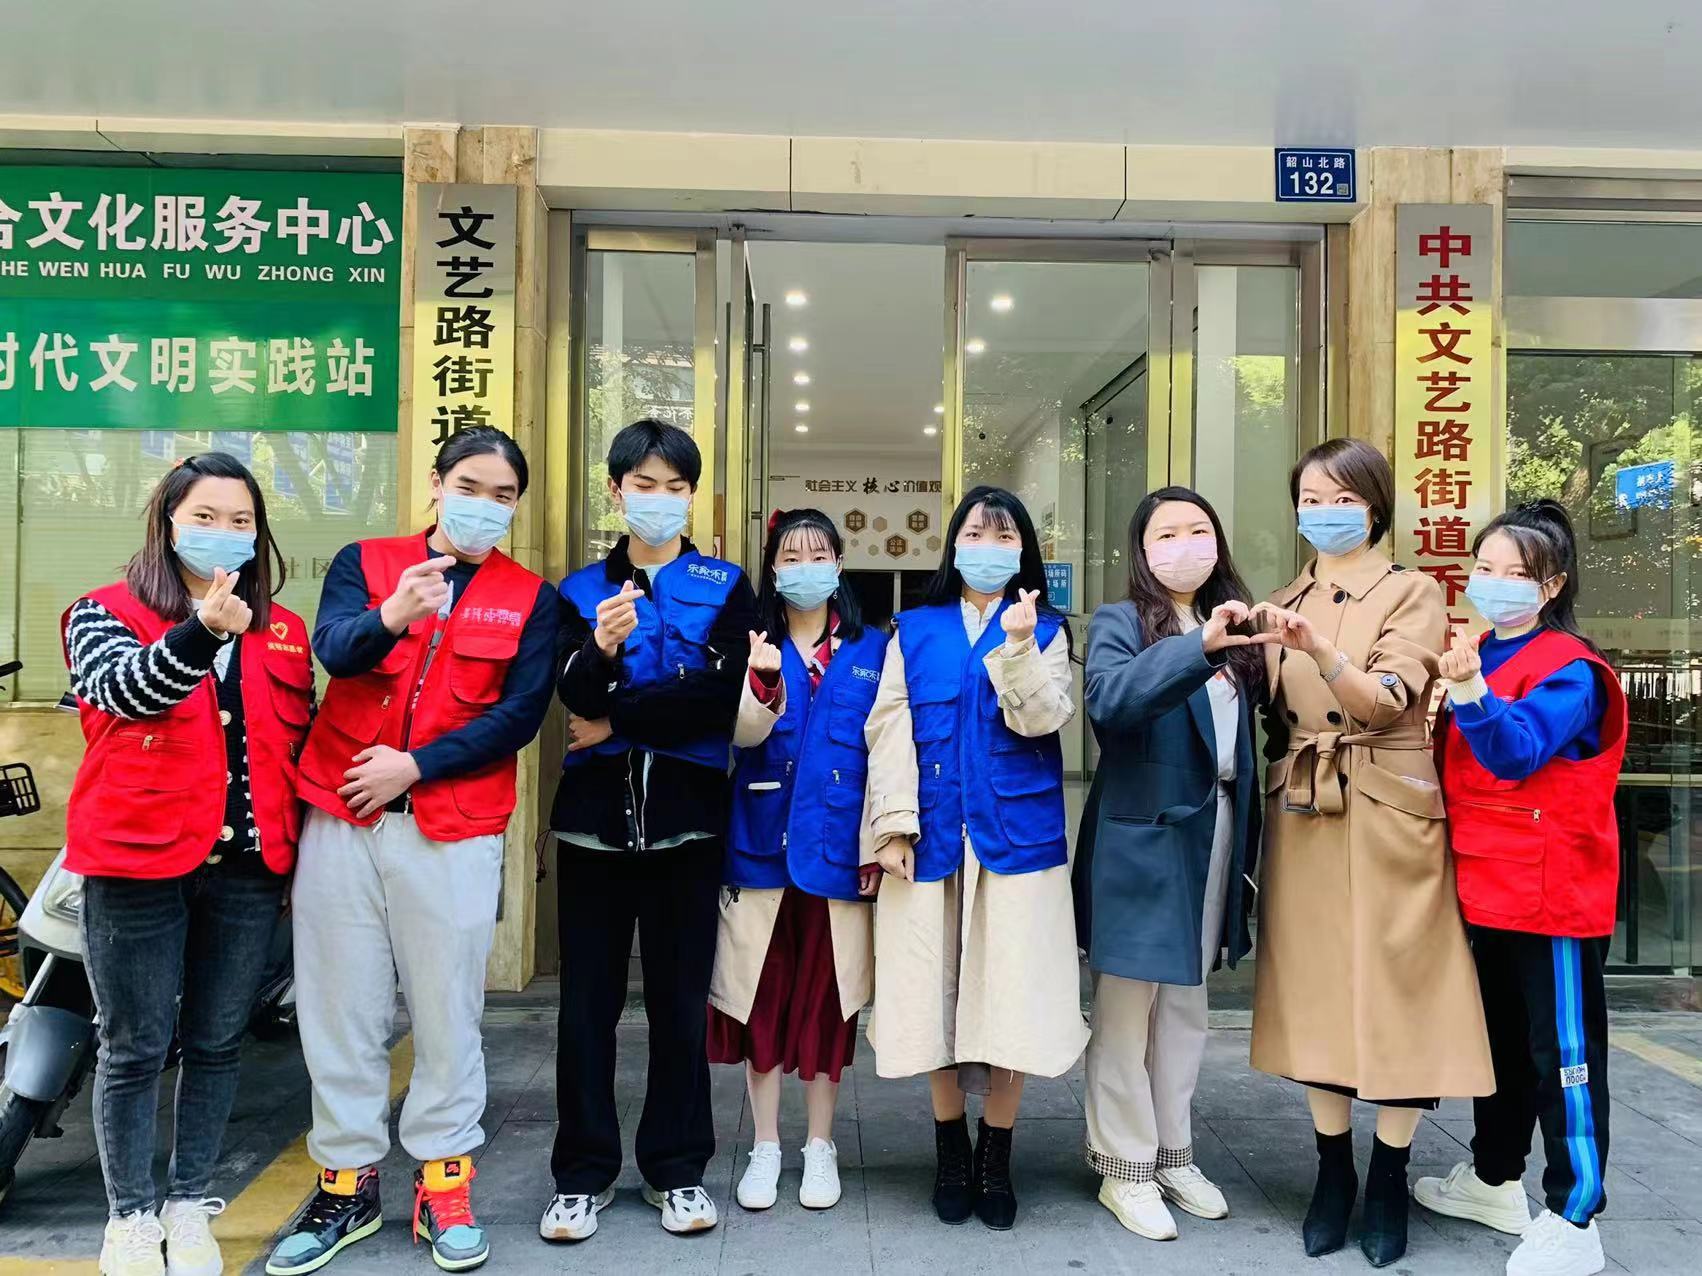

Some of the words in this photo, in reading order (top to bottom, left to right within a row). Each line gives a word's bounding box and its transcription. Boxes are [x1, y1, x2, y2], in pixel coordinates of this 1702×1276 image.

[1286, 156, 1346, 169] 韶山北路
[1290, 172, 1334, 194] 132
[1, 260, 29, 276] HE
[39, 261, 89, 278] WEN
[100, 262, 147, 279] HUA
[163, 263, 191, 280] FU
[205, 264, 242, 281] WU
[257, 265, 334, 282] ZHONG
[348, 267, 385, 283] XIN
